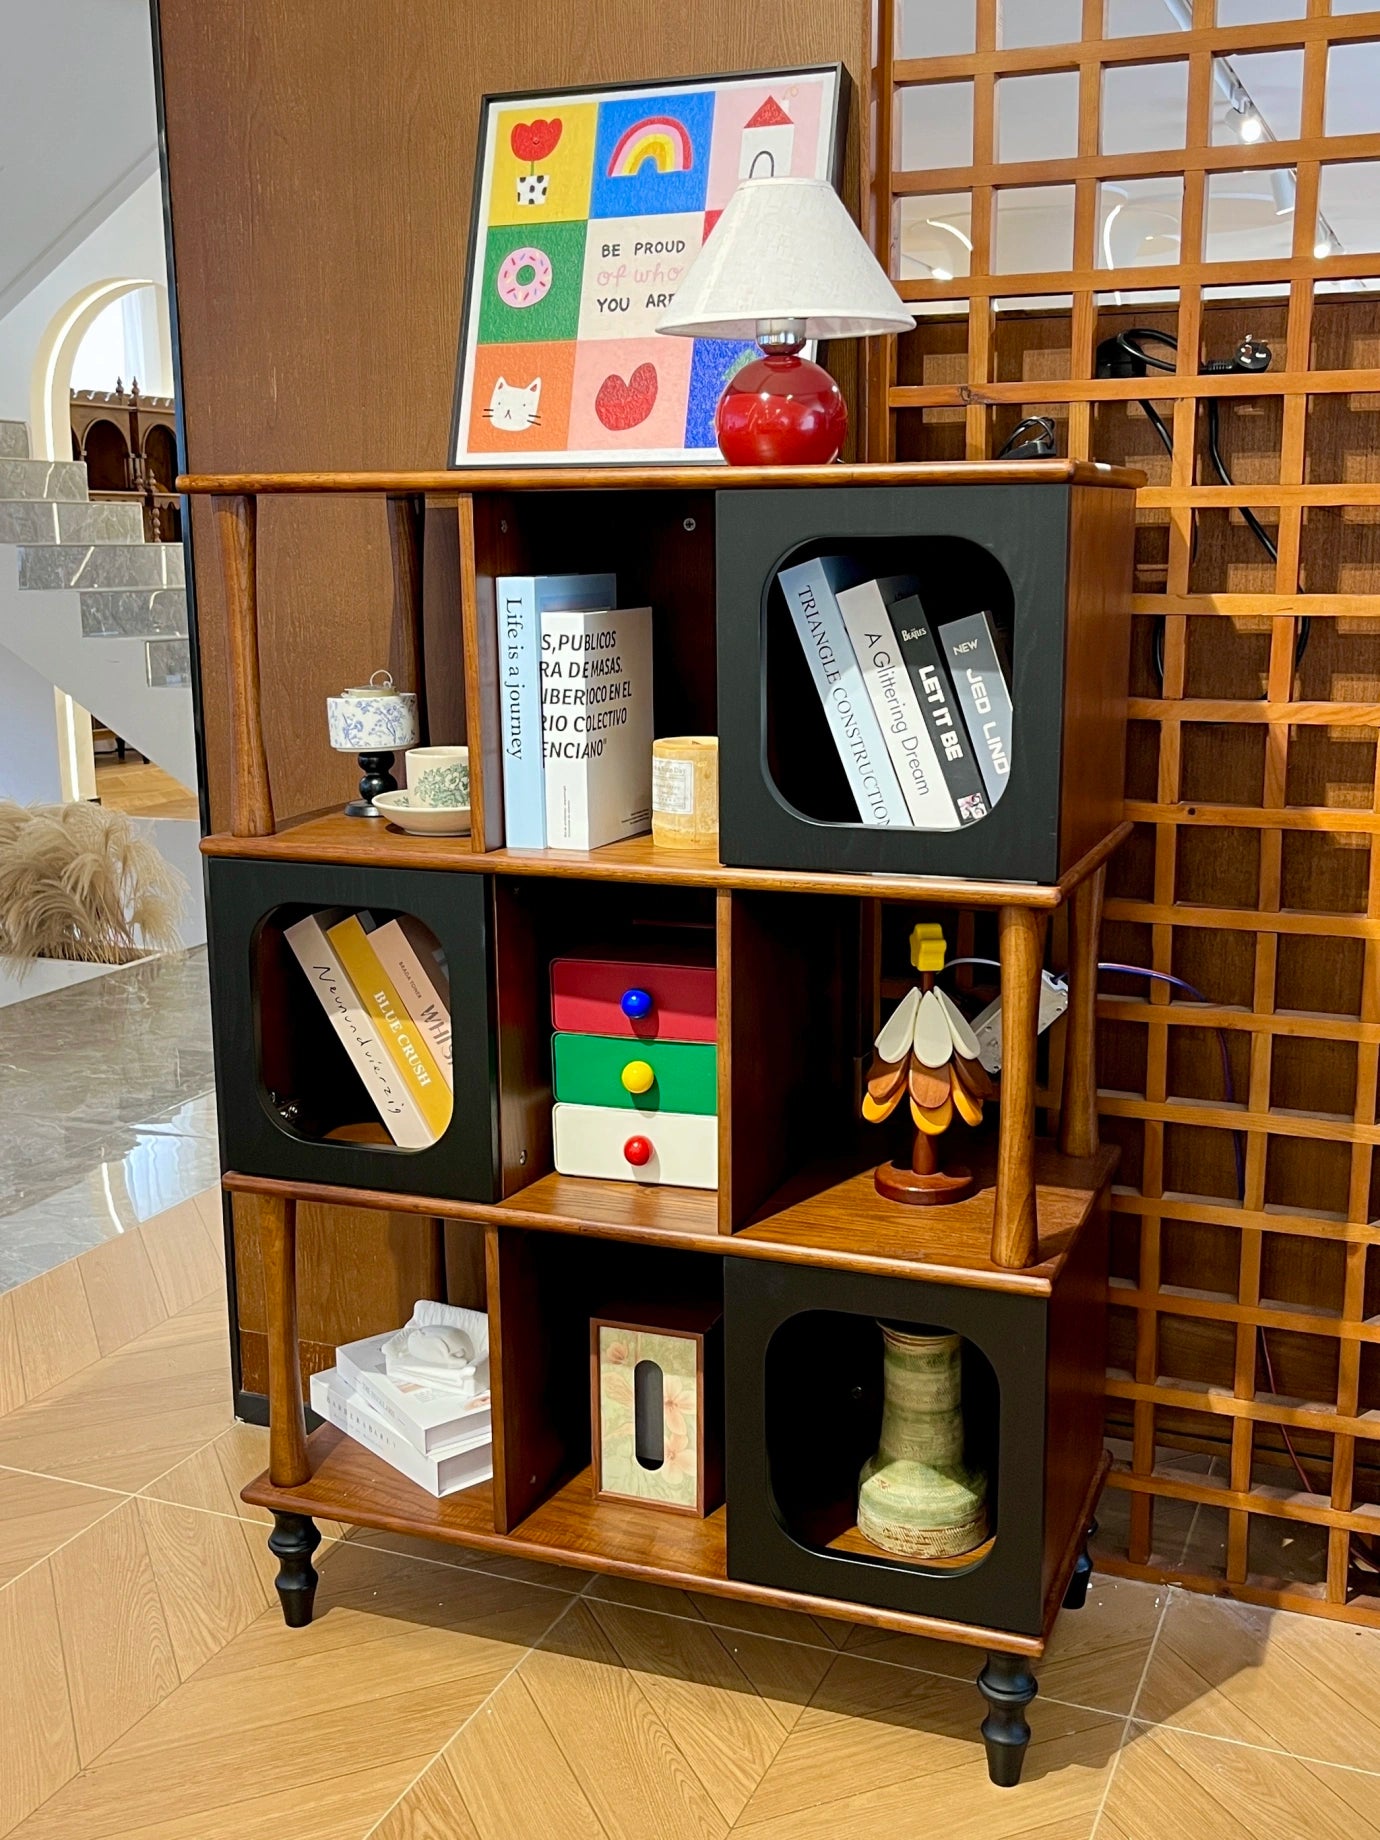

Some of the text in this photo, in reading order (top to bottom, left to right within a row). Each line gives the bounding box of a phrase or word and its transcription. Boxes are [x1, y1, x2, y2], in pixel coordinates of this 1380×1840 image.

[600, 240, 686, 258] BE PROUD
[596, 262, 685, 288] of who
[596, 297, 631, 313] YOU
[798, 584, 842, 685] TRIANGLE
[952, 639, 979, 656] NEW
[504, 598, 526, 760] Life is a journey
[568, 661, 590, 679] DE
[591, 656, 624, 678] MASAS.
[609, 682, 621, 701] EN
[622, 680, 633, 698] EL
[573, 707, 628, 733] COLECTIVO
[864, 633, 931, 797] A Glittering Dream
[918, 664, 965, 762] LET IT BE
[966, 668, 1011, 775] JED LIND
[373, 990, 432, 1087] BLUE CRUSH
